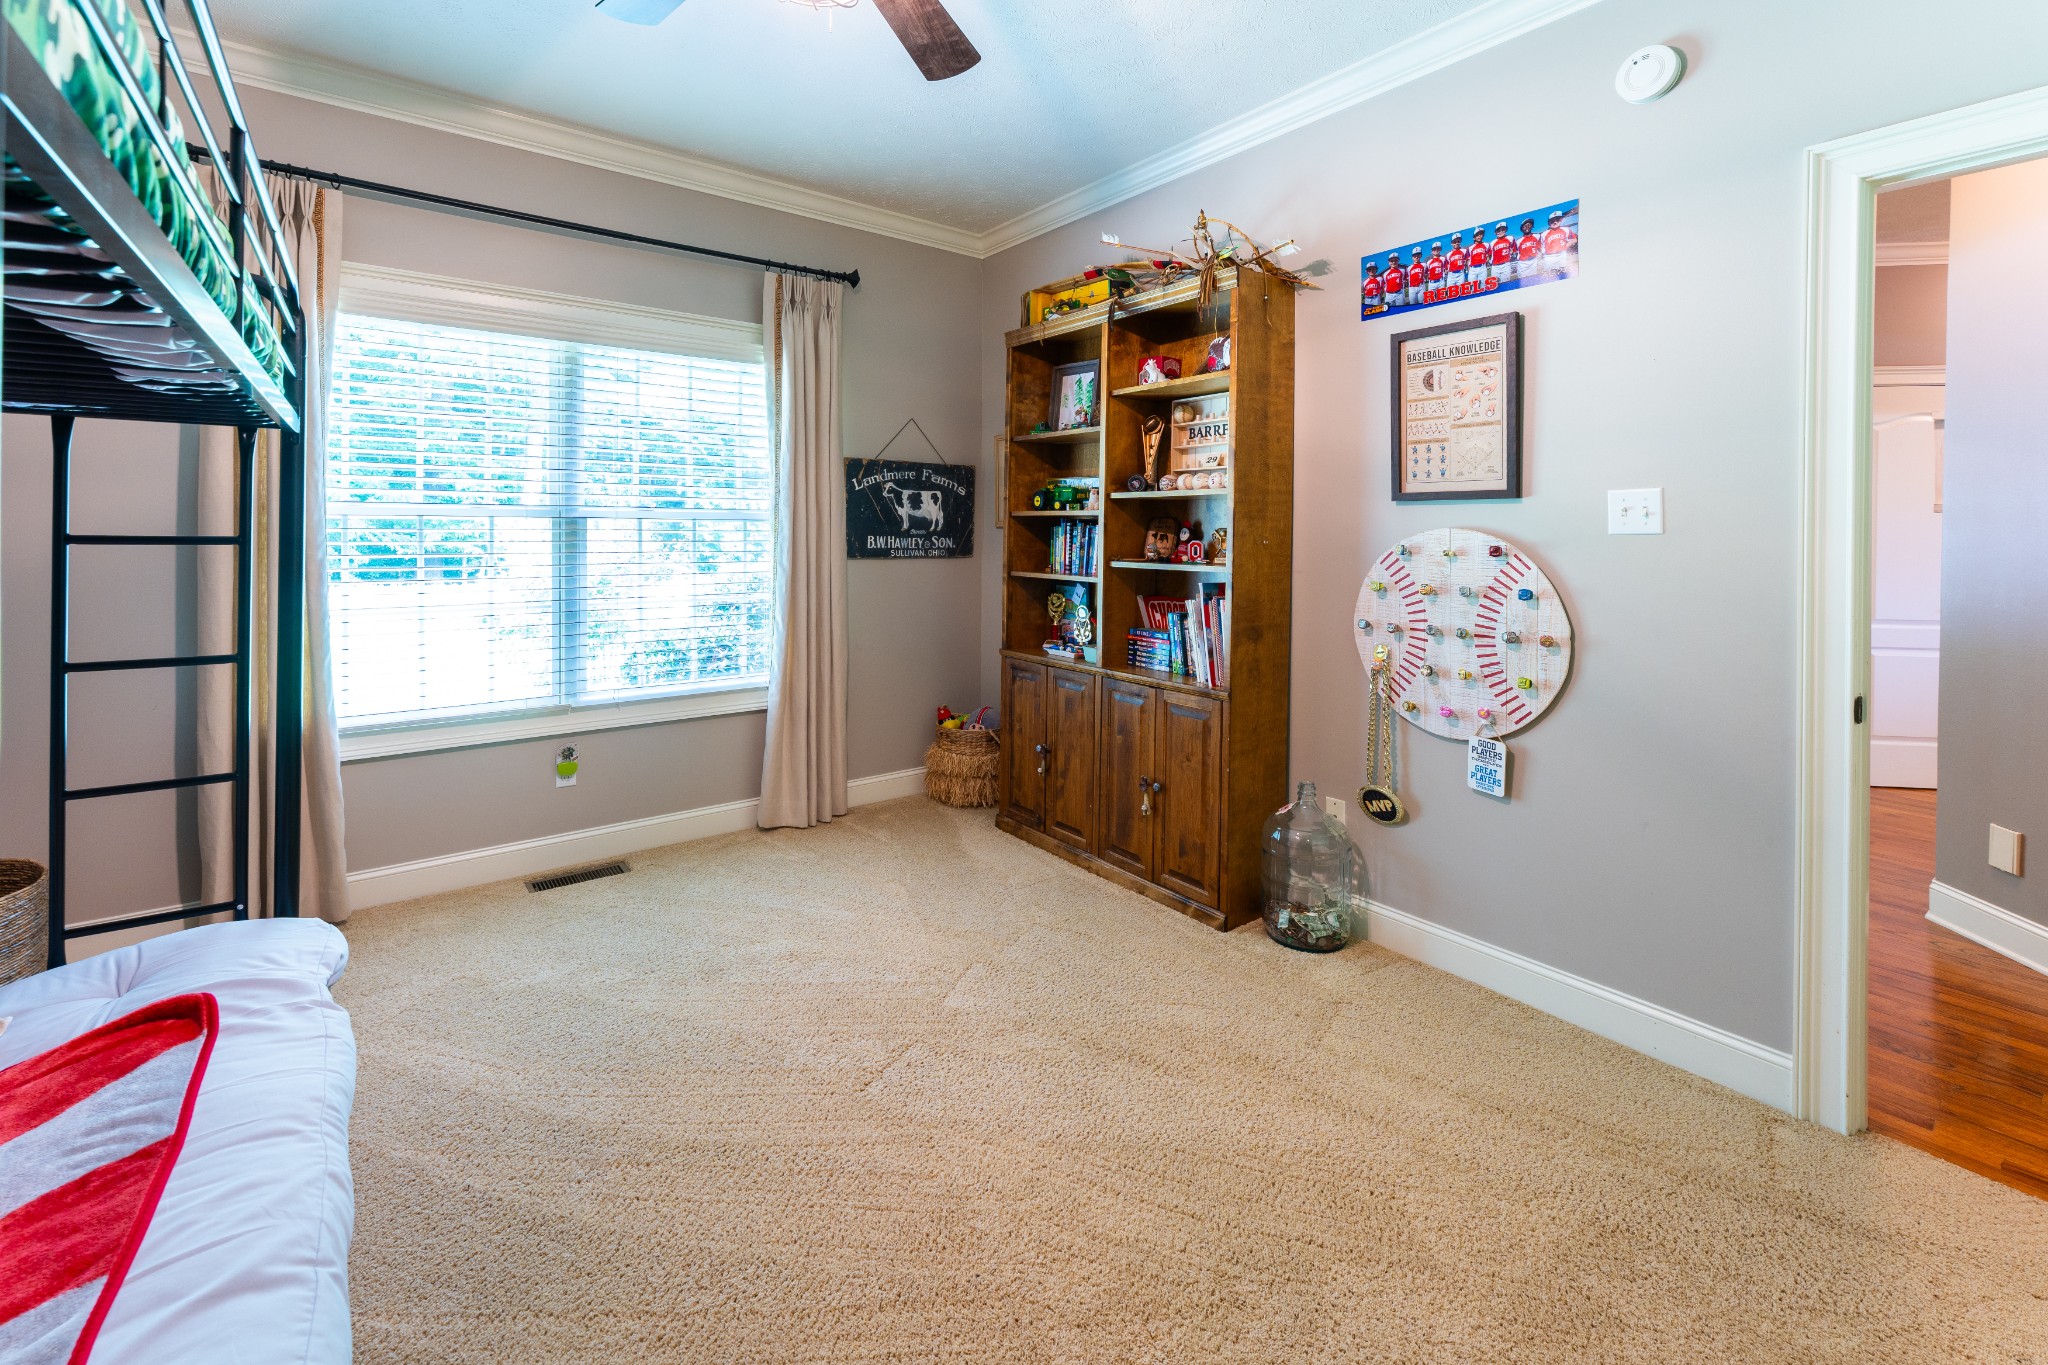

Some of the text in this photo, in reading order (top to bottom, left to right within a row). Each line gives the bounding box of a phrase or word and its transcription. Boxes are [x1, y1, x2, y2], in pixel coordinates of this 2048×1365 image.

[1423, 276, 1498, 305] REBELS
[1407, 348, 1446, 363] BASEBALL
[1449, 339, 1501, 357] KNOWLEDGE
[1206, 456, 1218, 464] 29
[852, 468, 916, 491] Landmere
[1471, 745, 1503, 761] PLAYERS
[1477, 739, 1497, 751] GOOD
[1474, 764, 1498, 778] GREAT
[1470, 771, 1502, 788] PLAYERS
[1365, 799, 1393, 813] MVP
